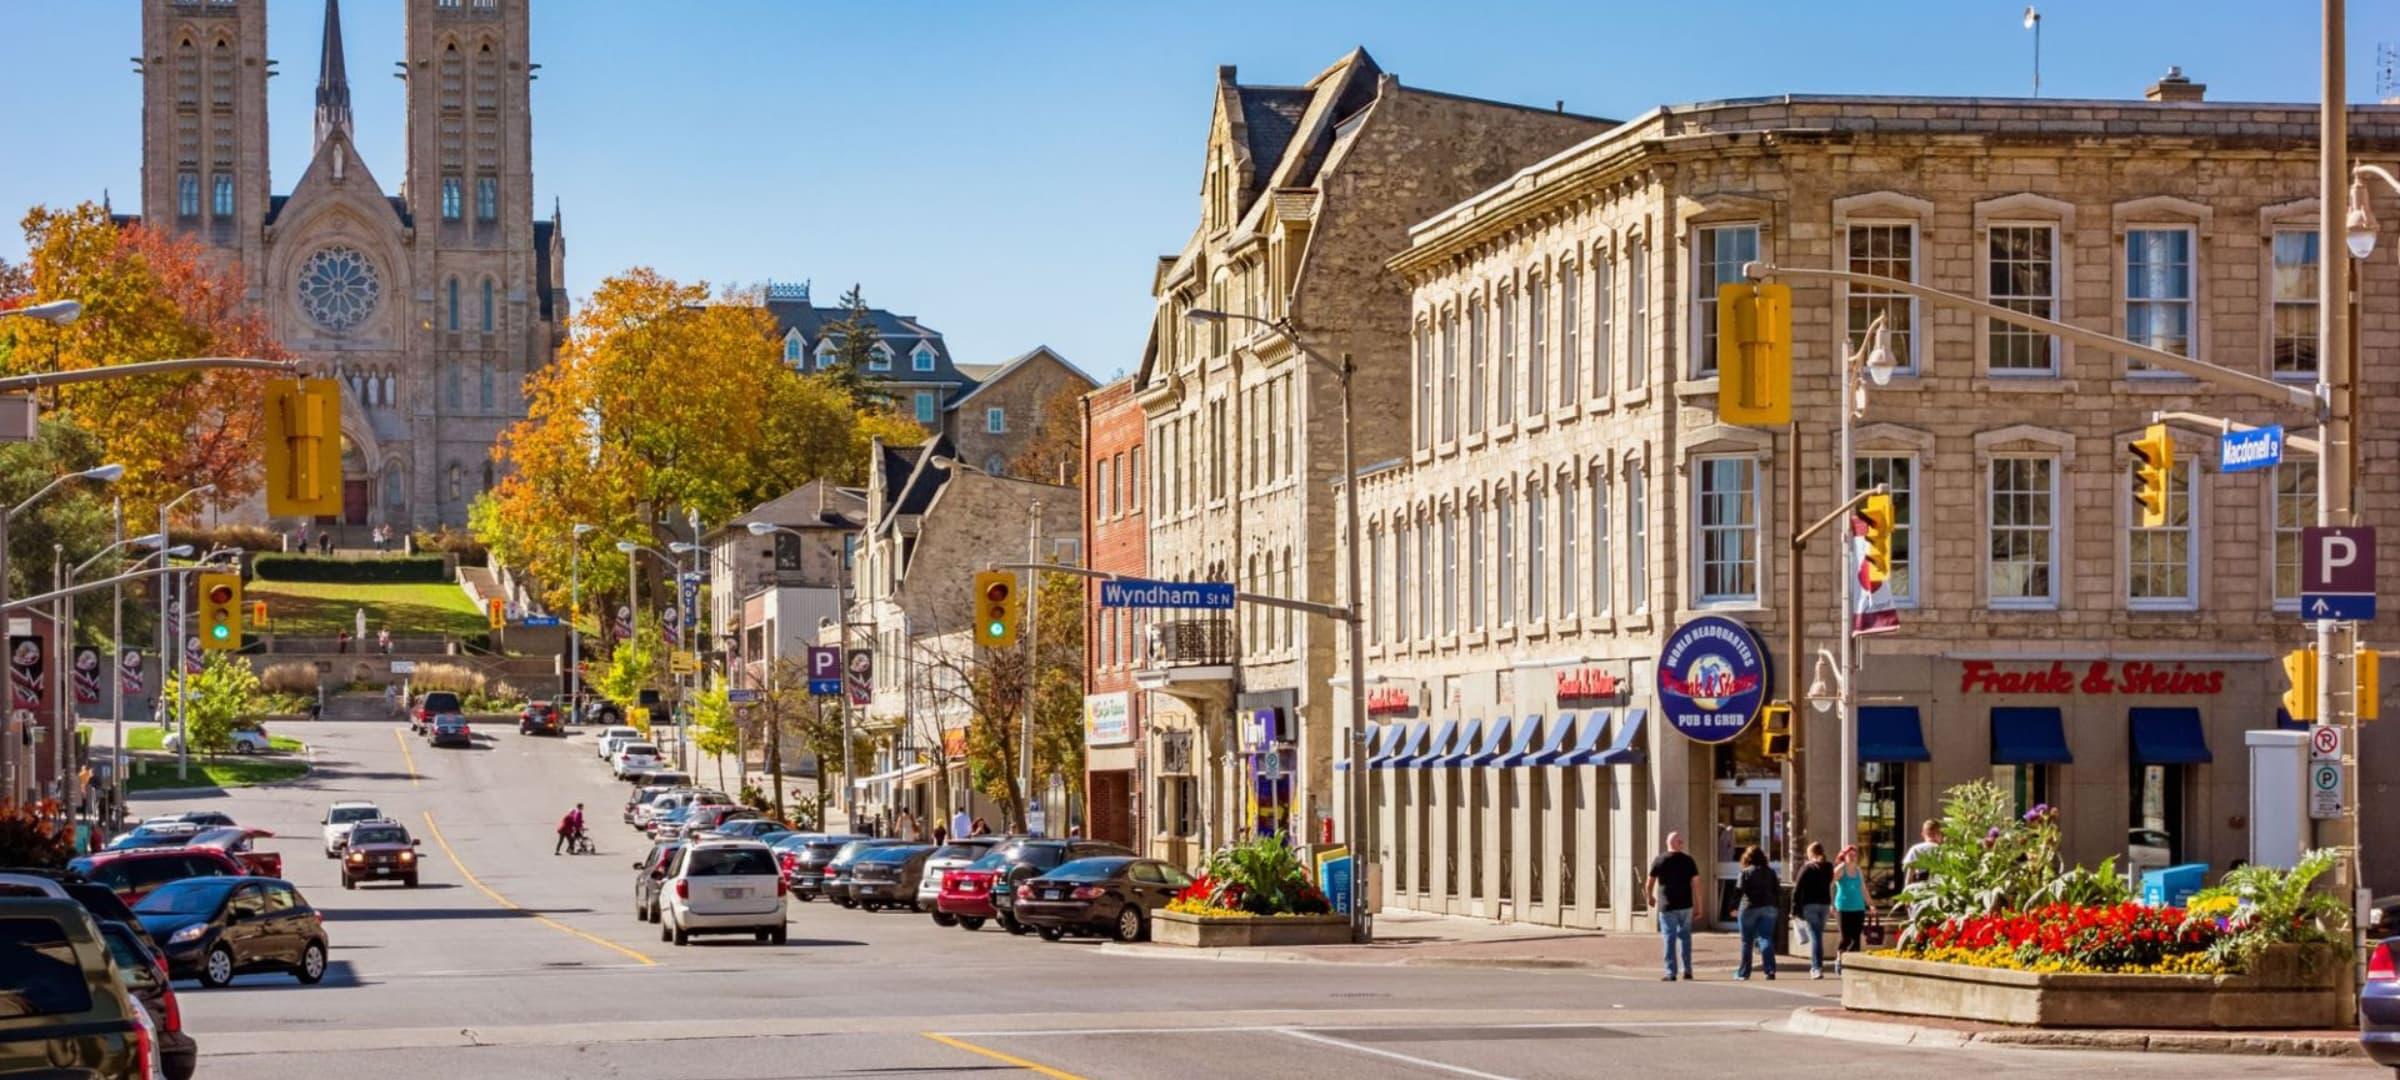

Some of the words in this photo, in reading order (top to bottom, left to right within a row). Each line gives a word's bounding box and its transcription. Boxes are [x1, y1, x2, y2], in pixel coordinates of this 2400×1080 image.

[2223, 432, 2270, 464] Macdonell
[2322, 536, 2356, 584] P
[1106, 584, 1200, 607] Wyndham
[1207, 593, 1218, 604] St
[1221, 594, 1230, 604] N
[1667, 633, 1693, 667] WORLD
[1691, 625, 1754, 667] HEADQUARTERS
[815, 652, 833, 676] P
[1961, 660, 2075, 694] Frank
[2080, 660, 2114, 694] &
[2118, 661, 2225, 694] Steins
[1679, 714, 1701, 726] PUB
[1714, 714, 1745, 726] GRUB
